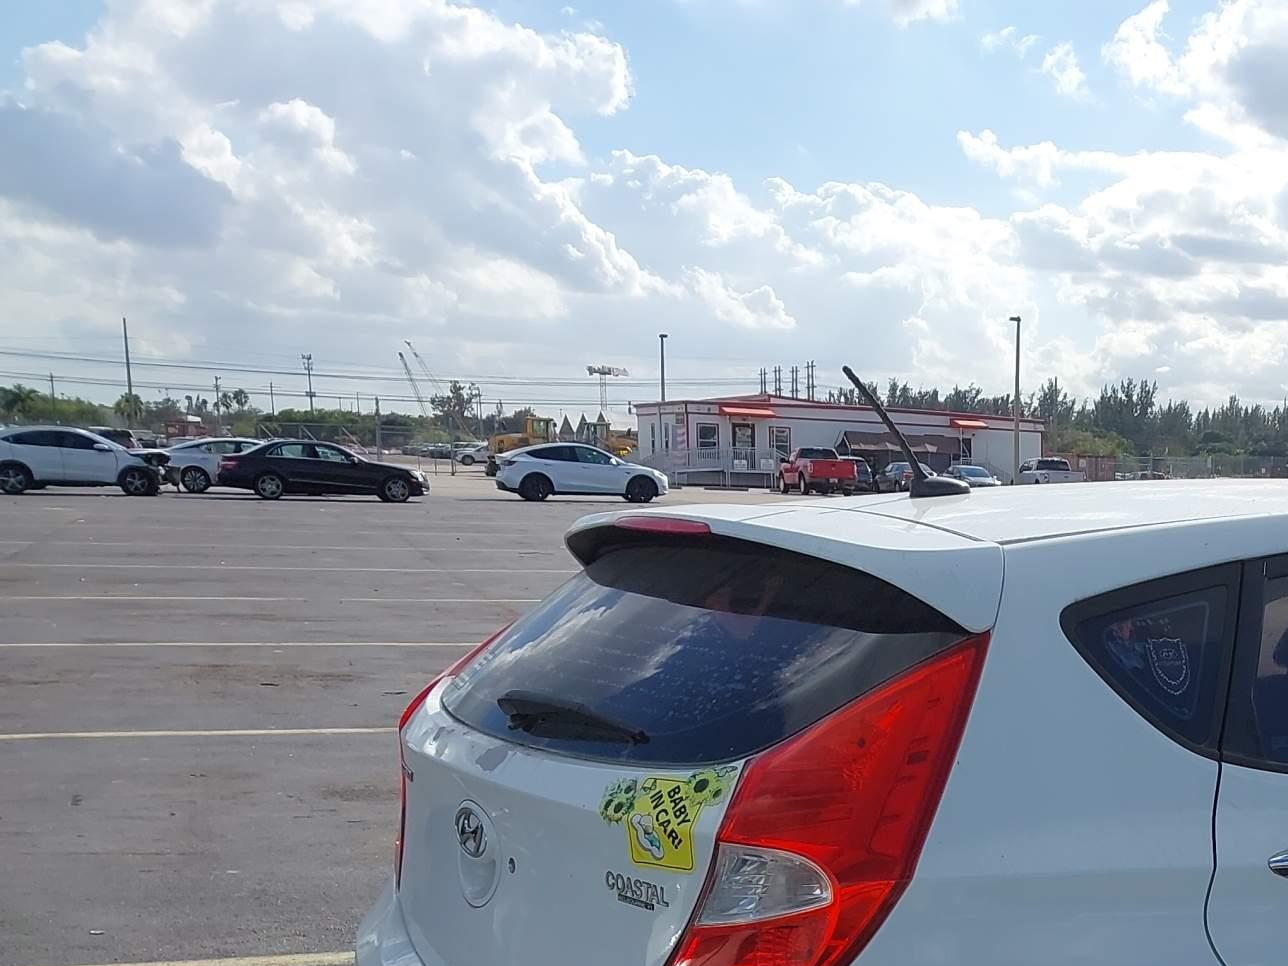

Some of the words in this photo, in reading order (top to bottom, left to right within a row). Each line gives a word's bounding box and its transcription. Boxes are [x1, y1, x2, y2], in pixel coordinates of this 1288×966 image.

[649, 789, 665, 811] IN
[667, 784, 691, 826] BABY
[655, 808, 683, 850] CAR!
[605, 870, 669, 908] COASTAL
